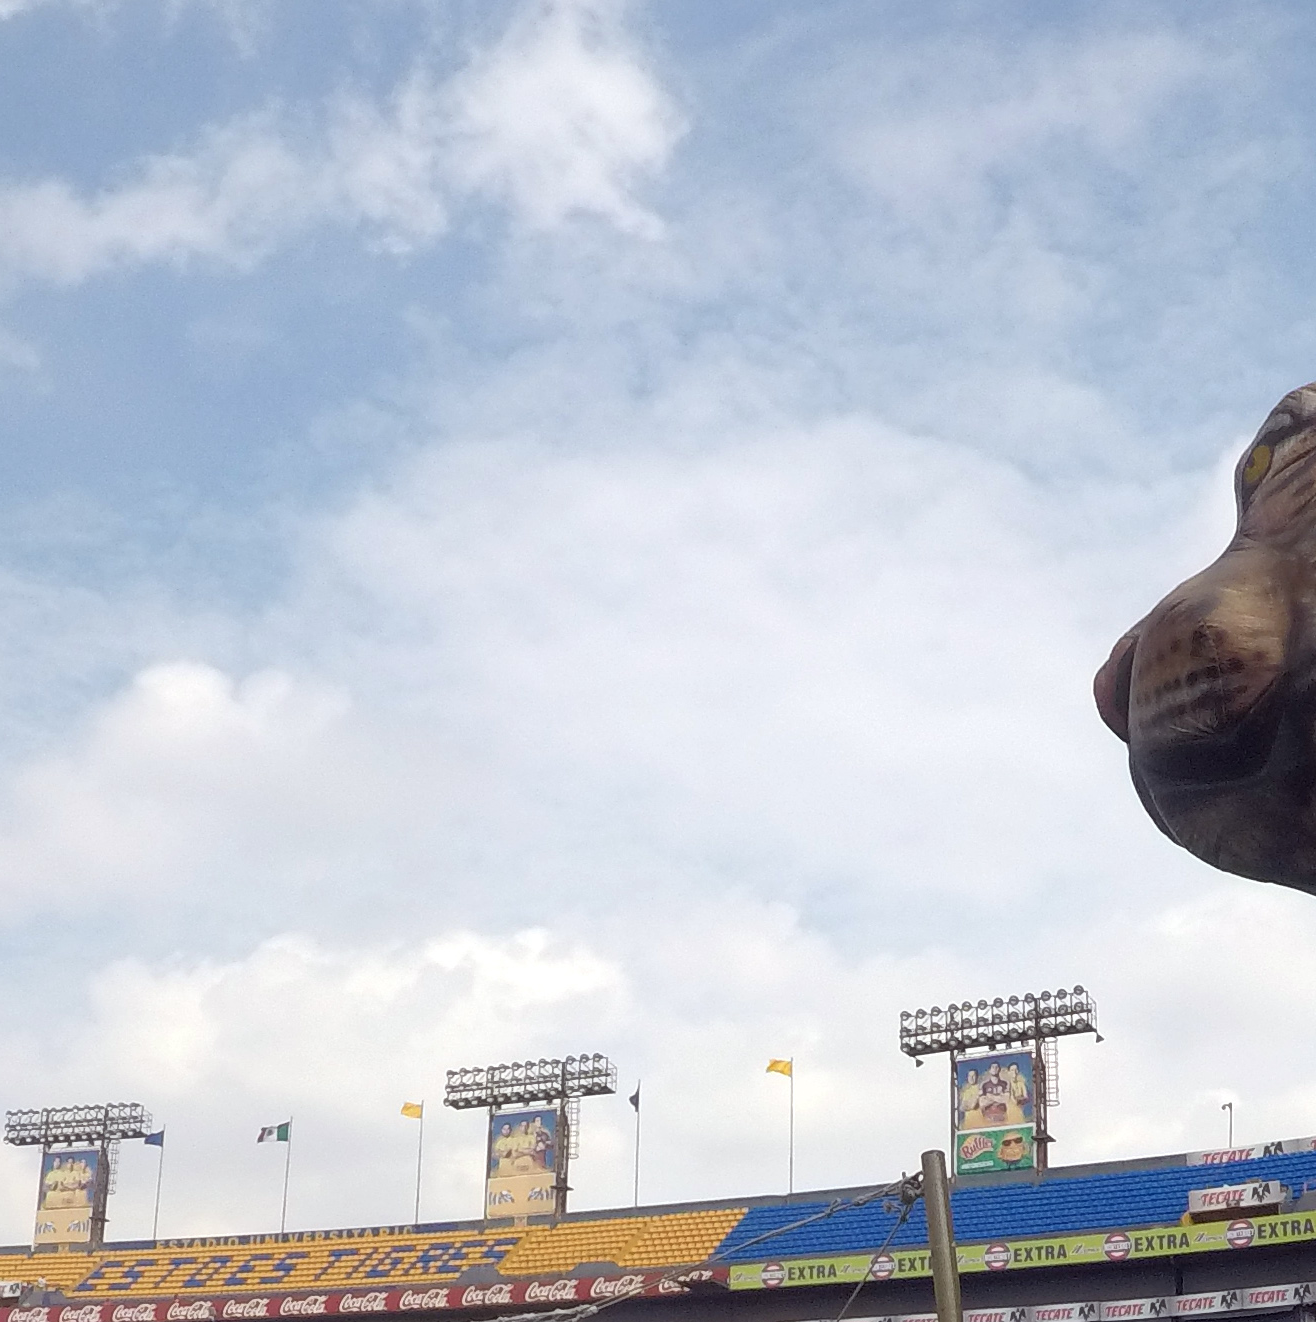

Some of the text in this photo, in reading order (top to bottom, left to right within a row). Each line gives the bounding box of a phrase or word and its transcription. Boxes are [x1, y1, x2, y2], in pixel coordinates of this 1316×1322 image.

[1202, 1148, 1256, 1165] TECATE
[1201, 1188, 1247, 1206] TECATE
[1257, 1218, 1314, 1240] EXTRA
[1134, 1233, 1190, 1253] EXTRA
[1014, 1244, 1067, 1263] EXTRA
[788, 1263, 836, 1280] EXTRA
[898, 1256, 933, 1272] EXT
[1176, 1296, 1215, 1310] TECATE
[1248, 1289, 1289, 1304] TECATE
[1035, 1308, 1074, 1321] TECATE
[1105, 1304, 1145, 1317] TECATE
